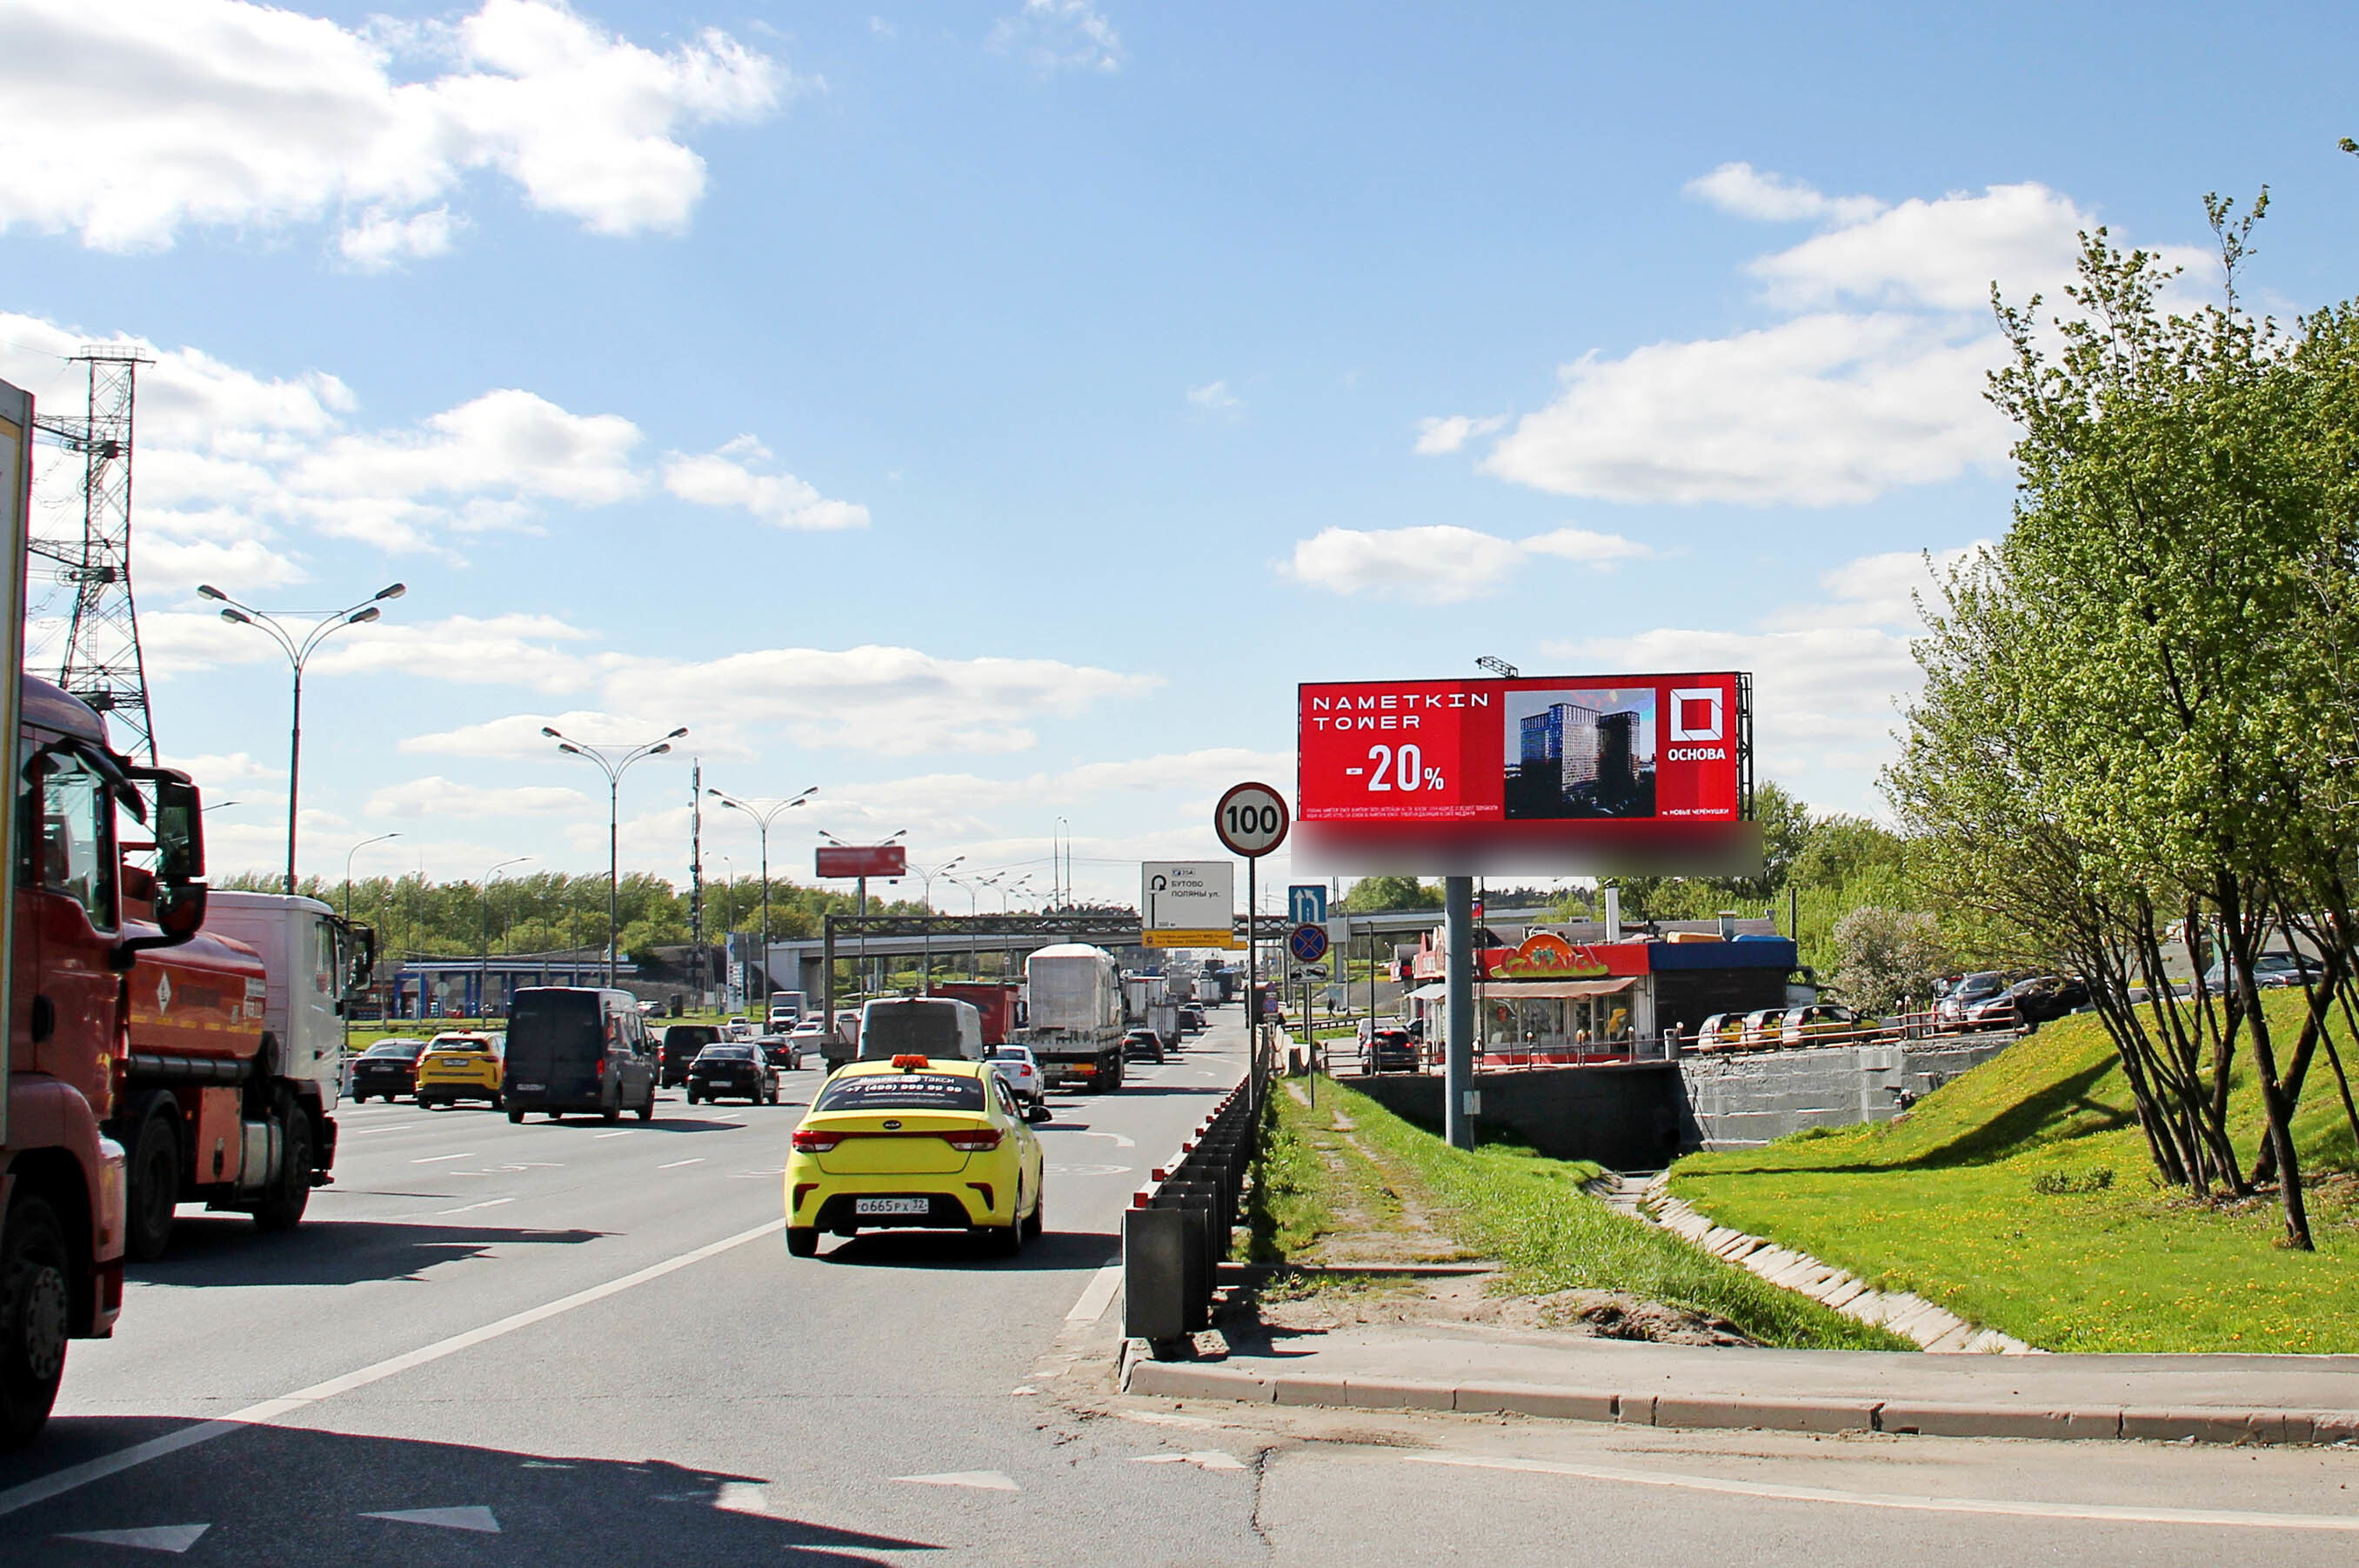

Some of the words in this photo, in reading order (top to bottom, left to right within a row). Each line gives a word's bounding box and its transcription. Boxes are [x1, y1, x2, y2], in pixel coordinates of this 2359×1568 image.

[1313, 693, 1488, 710] NAMETKIN
[1313, 715, 1420, 731] TOWER
[1667, 748, 1727, 761] ОСНОВА
[1226, 805, 1278, 834] 100
